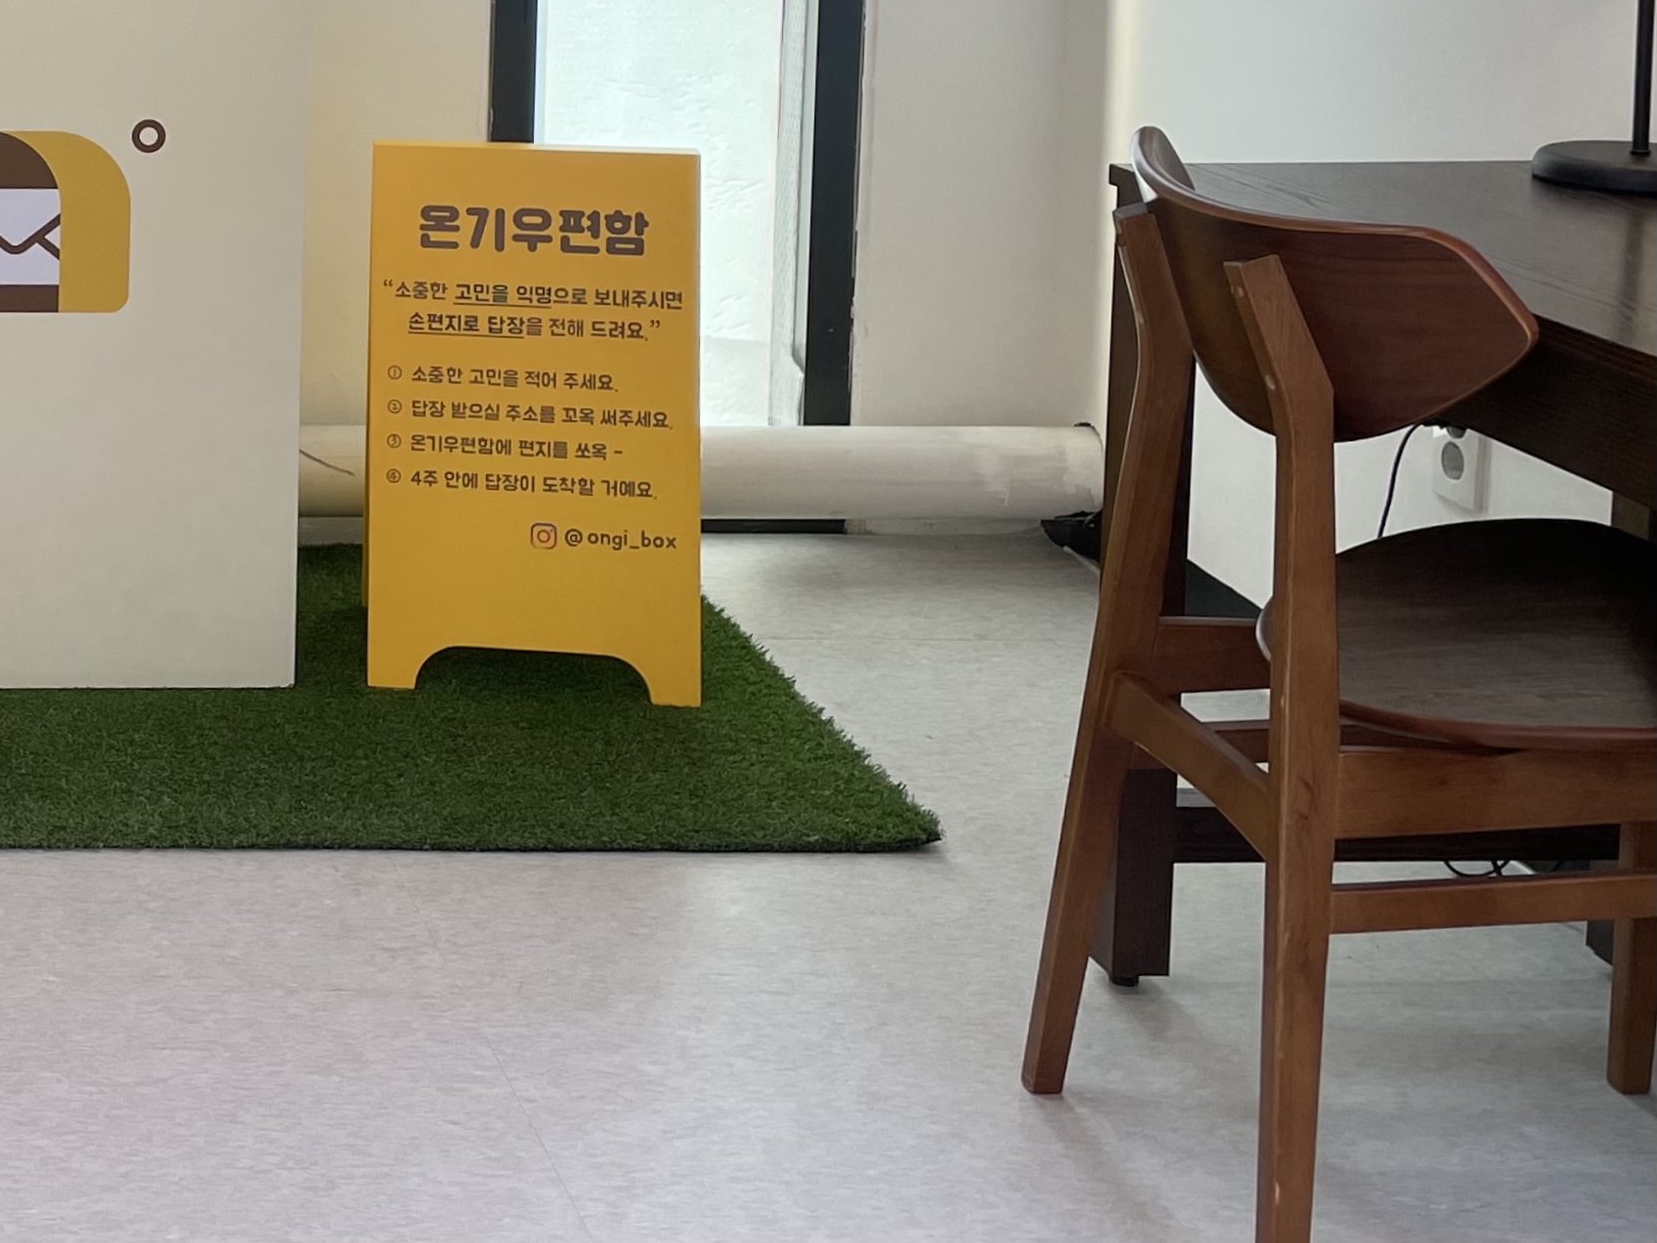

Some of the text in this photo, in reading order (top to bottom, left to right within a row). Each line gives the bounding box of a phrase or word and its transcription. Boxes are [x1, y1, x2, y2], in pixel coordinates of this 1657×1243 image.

[419, 204, 649, 256] 온기우편함
[455, 283, 509, 303] 고민을
[516, 286, 588, 305] 익명으로
[594, 288, 682, 310] 보내주시면
[408, 312, 480, 333] 손편지로
[487, 315, 543, 336] 답장을
[549, 318, 584, 338] 전해
[411, 365, 463, 384] 소중한
[469, 369, 519, 388] 고민을
[524, 371, 557, 389] 적어
[563, 372, 619, 393] 주세요.
[411, 400, 446, 418] 답장
[451, 402, 500, 421] 받으실
[506, 405, 556, 424] 주소를
[561, 407, 595, 426] 꼬옥
[600, 409, 674, 430] 써주세요.
[410, 434, 512, 456] 온기우편함에
[518, 440, 568, 459] 편지를
[574, 443, 607, 461] 쏘옥
[410, 470, 439, 488] 4주
[444, 471, 478, 489] 안에
[485, 473, 535, 493] 답장이
[542, 476, 595, 497] 도착할
[600, 479, 657, 500] 거예요.
[564, 528, 677, 551] @ongi_box
